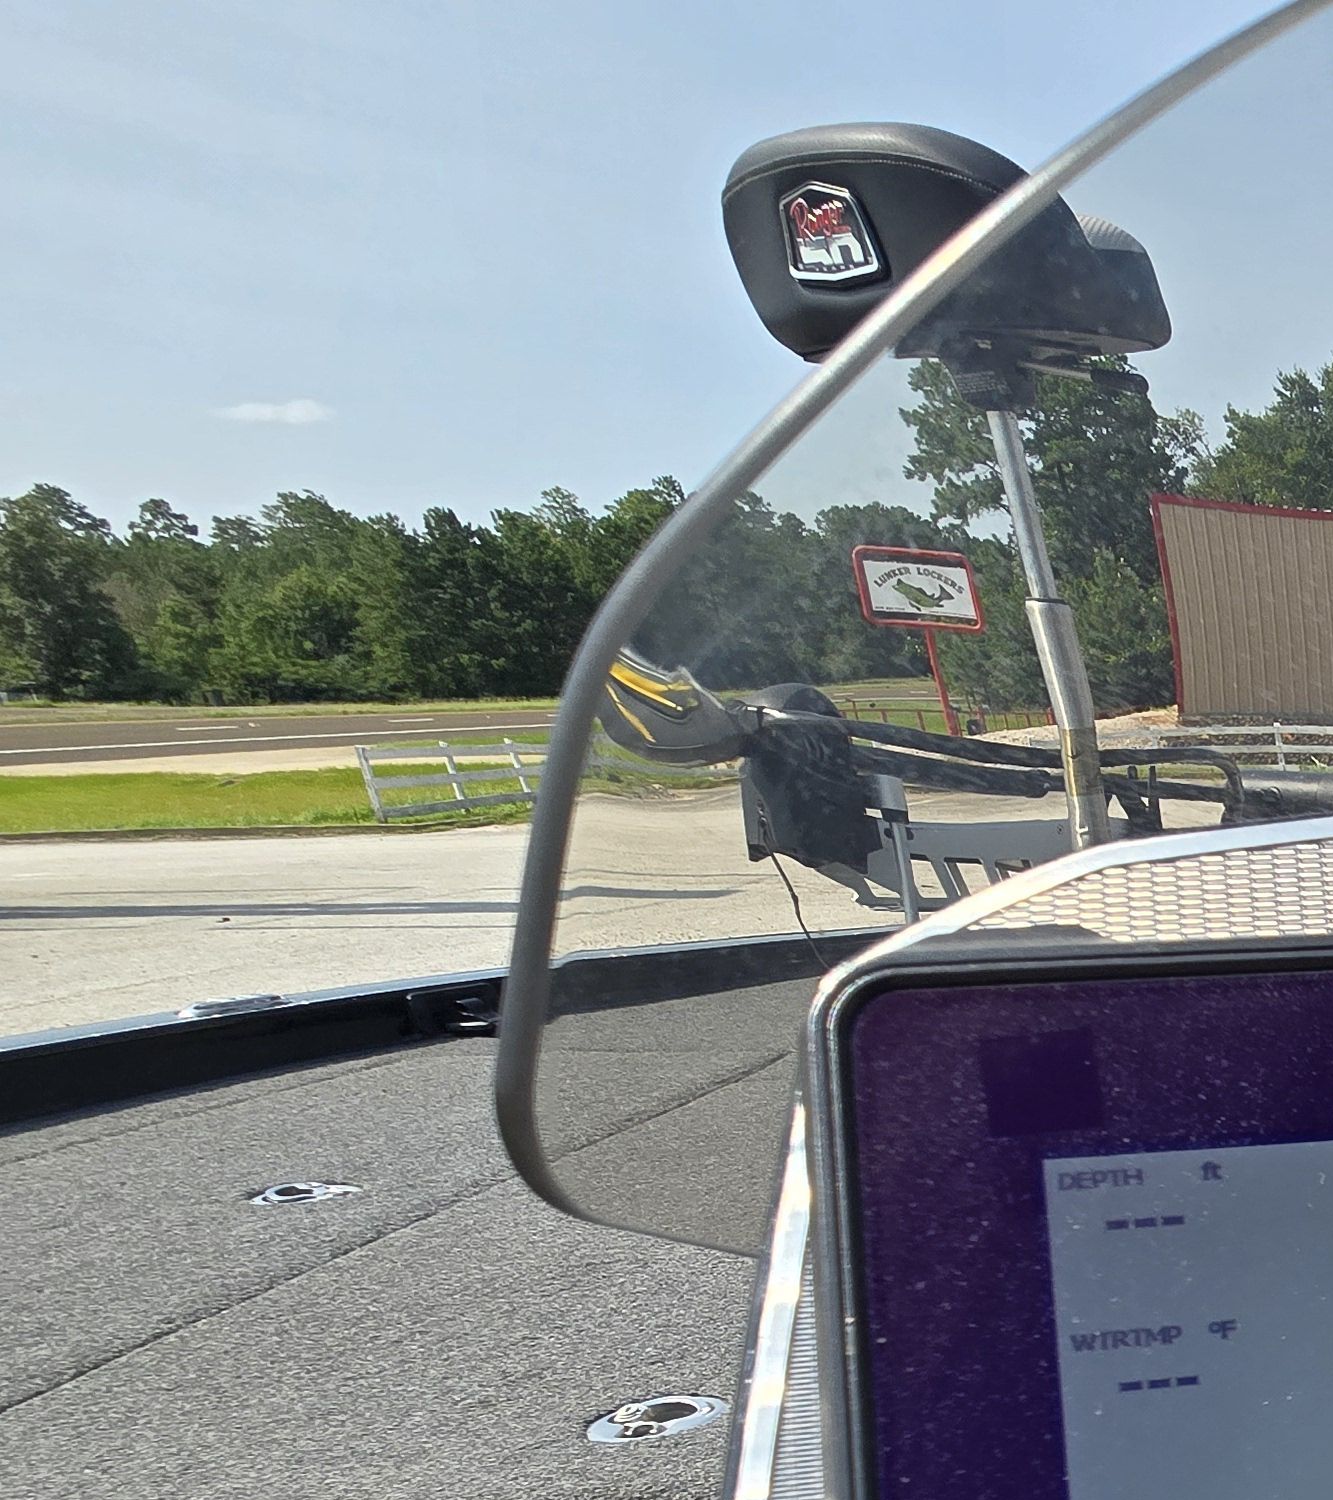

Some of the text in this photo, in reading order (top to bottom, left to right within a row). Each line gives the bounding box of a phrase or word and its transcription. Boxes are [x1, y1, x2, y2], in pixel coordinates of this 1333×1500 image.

[874, 567, 965, 594] LUNKER LOCKERS
[1057, 1160, 1223, 1191] DEPTH ft
[1070, 1324, 1183, 1352] WTRTMP
